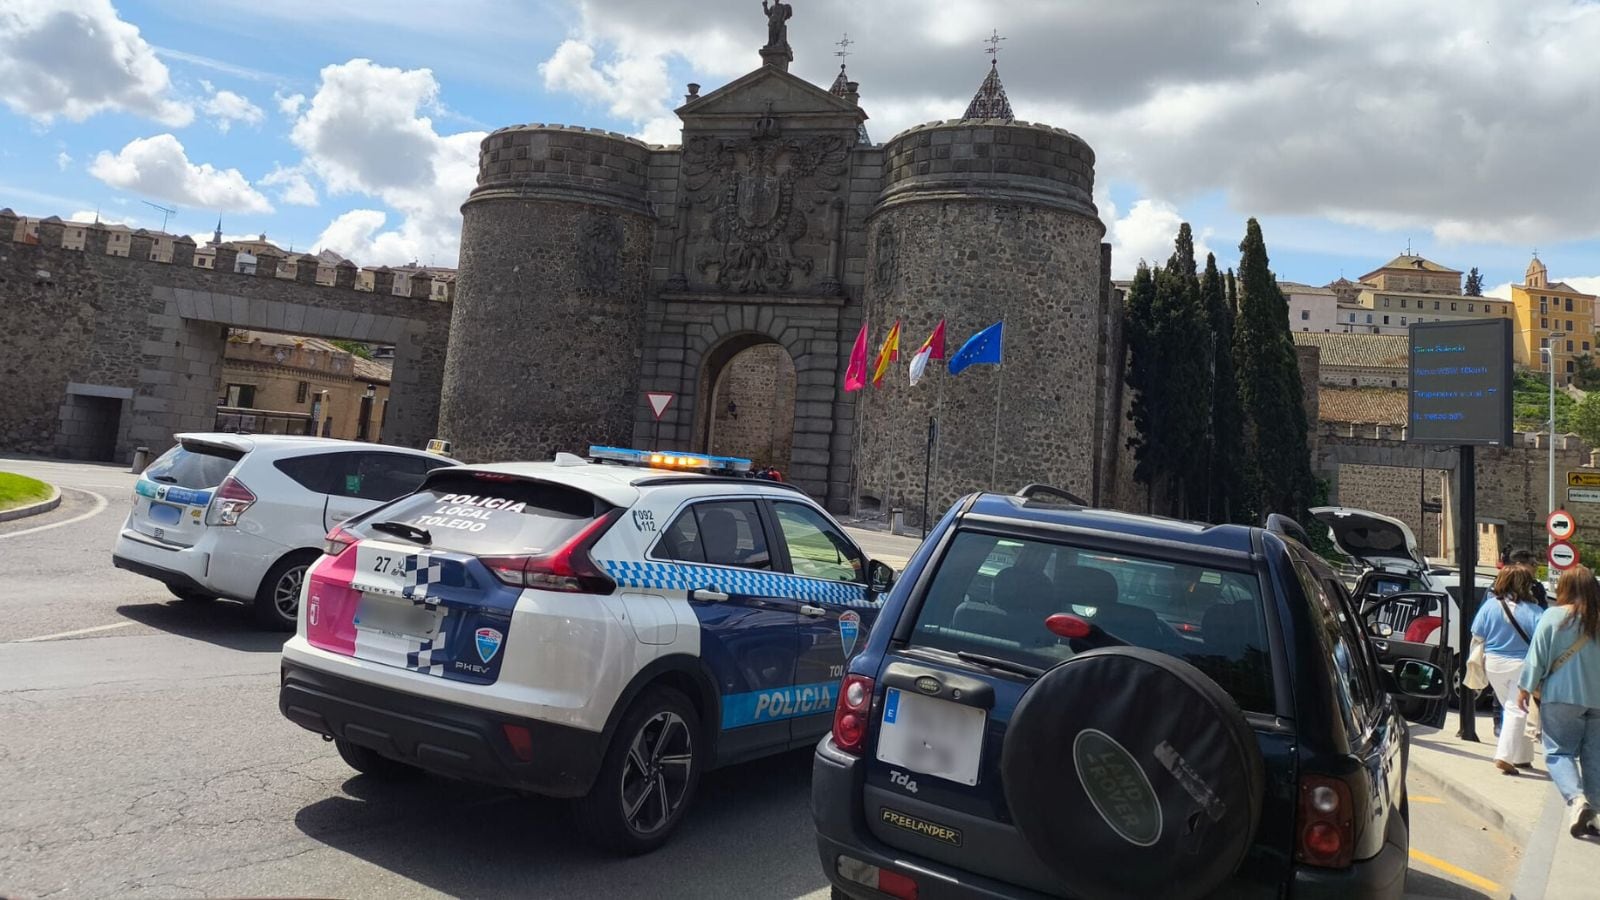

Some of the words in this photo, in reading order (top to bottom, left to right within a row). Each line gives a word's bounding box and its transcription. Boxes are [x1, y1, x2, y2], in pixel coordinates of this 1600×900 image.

[436, 493, 527, 513] POLICIA
[434, 505, 493, 520] LOCAL
[638, 510, 654, 520] 092
[416, 515, 487, 532] TOLEDO
[641, 521, 656, 531] 112
[374, 555, 391, 573] 27
[455, 661, 490, 673] PHEV
[754, 686, 831, 719] POLICIA
[887, 709, 894, 717] E
[890, 770, 918, 793] Td4
[1100, 752, 1143, 801] LAND
[1089, 765, 1140, 827] ROVER
[883, 811, 957, 843] FREELANDER
